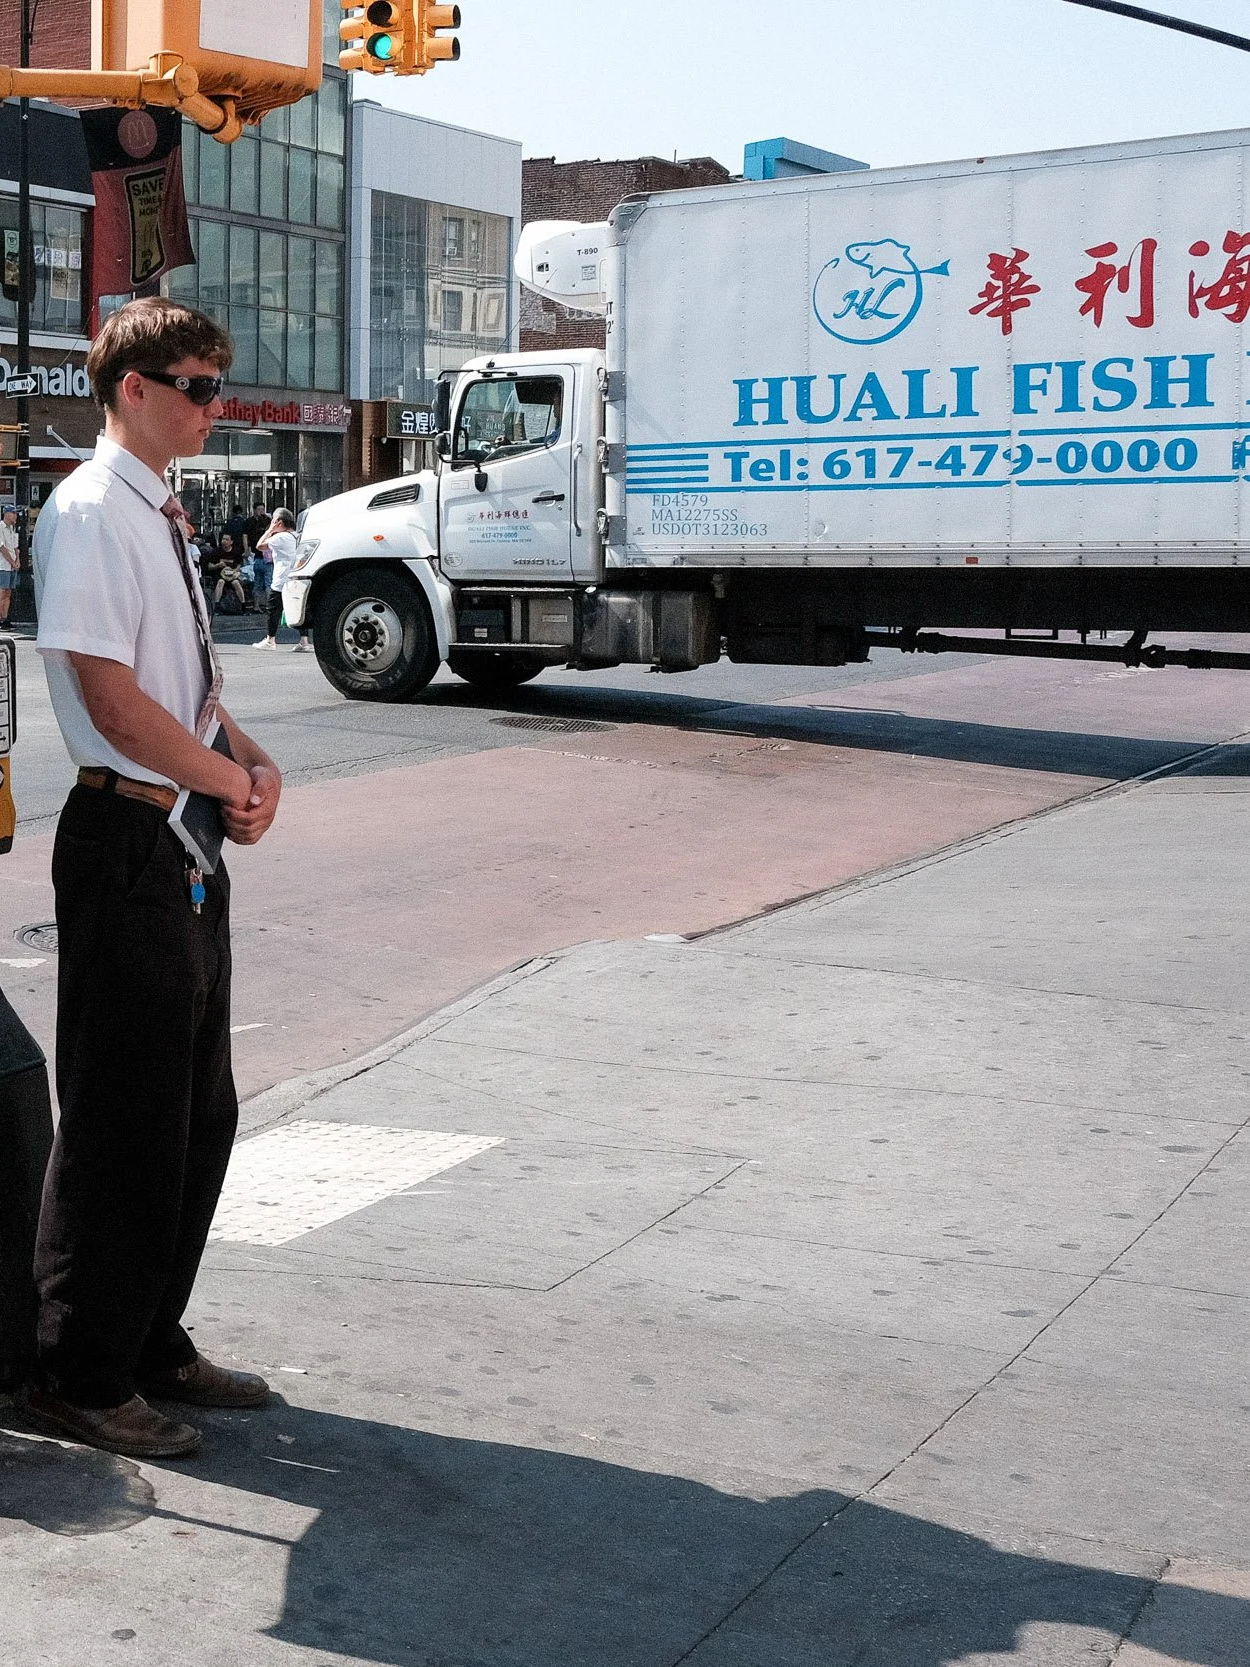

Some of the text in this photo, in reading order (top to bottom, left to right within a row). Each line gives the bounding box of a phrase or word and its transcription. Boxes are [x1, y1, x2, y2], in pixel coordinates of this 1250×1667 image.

[21, 379, 33, 389] WAY
[733, 365, 980, 428] HUALI
[1012, 353, 1216, 416] FISH
[223, 398, 300, 427] athay Bank
[724, 448, 810, 484] Tel:
[823, 438, 1199, 480] 617-479-0000
[652, 494, 709, 507] FD4579
[651, 508, 738, 521] MA12275SS
[652, 523, 768, 536] USDOT3123063
